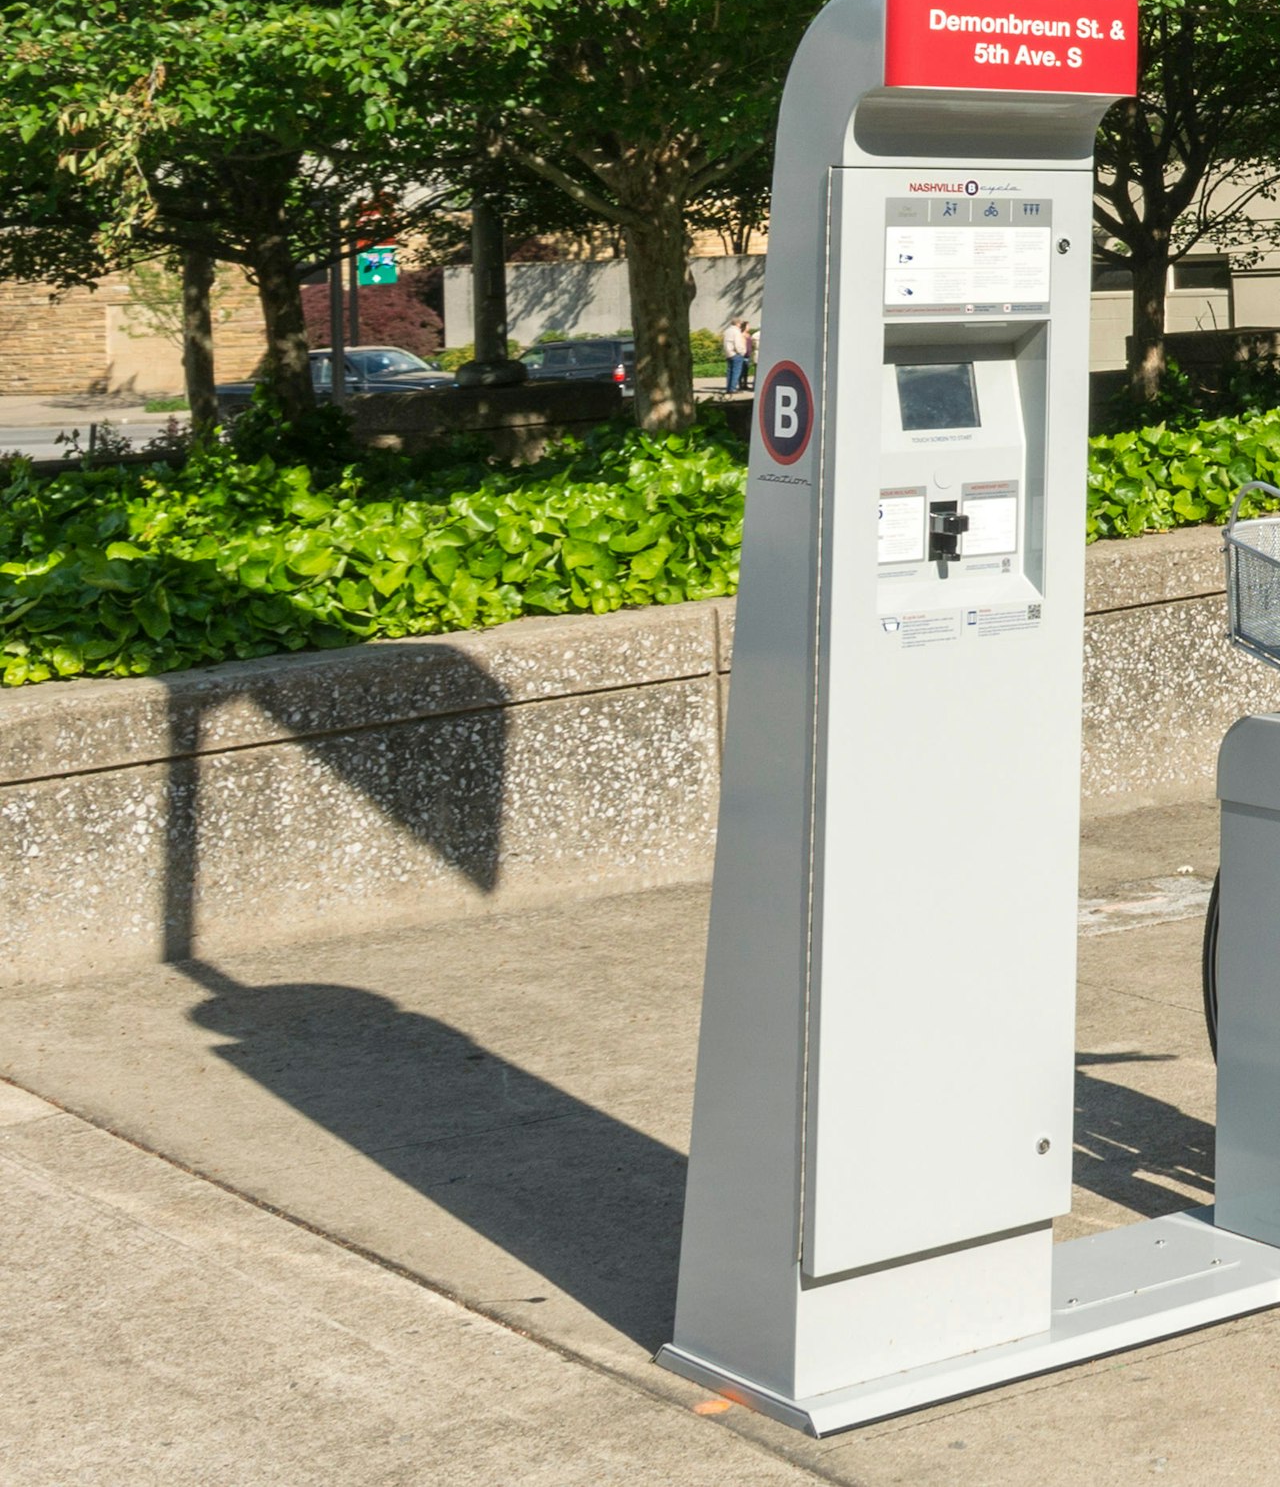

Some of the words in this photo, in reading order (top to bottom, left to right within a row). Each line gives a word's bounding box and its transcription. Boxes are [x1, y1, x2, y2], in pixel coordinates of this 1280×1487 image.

[929, 9, 1071, 38] Demonbreun
[1076, 17, 1104, 40] St.
[1109, 19, 1126, 41] &
[973, 43, 1011, 65] 5th
[1014, 46, 1061, 68] Ave.
[1067, 47, 1083, 68] S
[909, 183, 964, 193] NASHVILLE
[774, 385, 799, 439] B
[757, 473, 812, 486] station
